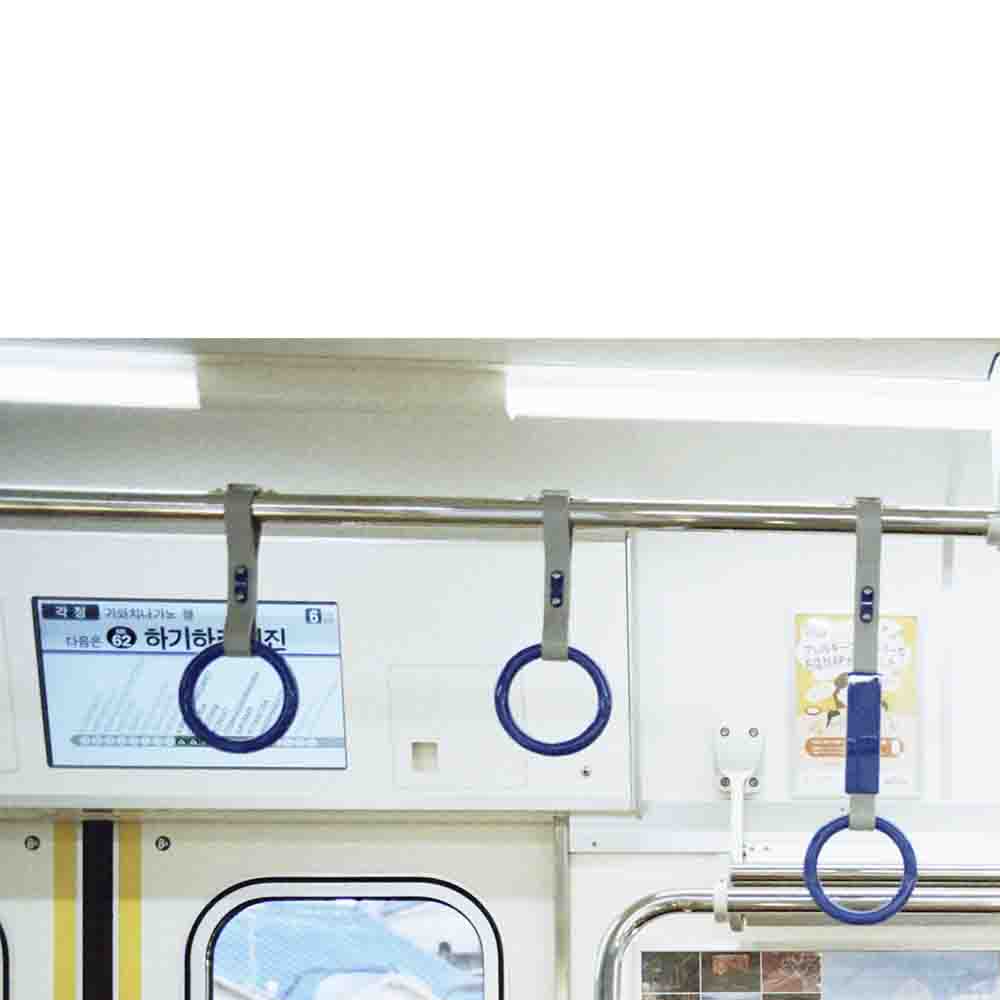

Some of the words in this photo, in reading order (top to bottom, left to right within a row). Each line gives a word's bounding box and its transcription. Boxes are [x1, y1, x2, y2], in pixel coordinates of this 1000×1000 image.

[308, 608, 320, 623] 6
[111, 634, 132, 648] 62
[144, 626, 288, 651] 하기하진
